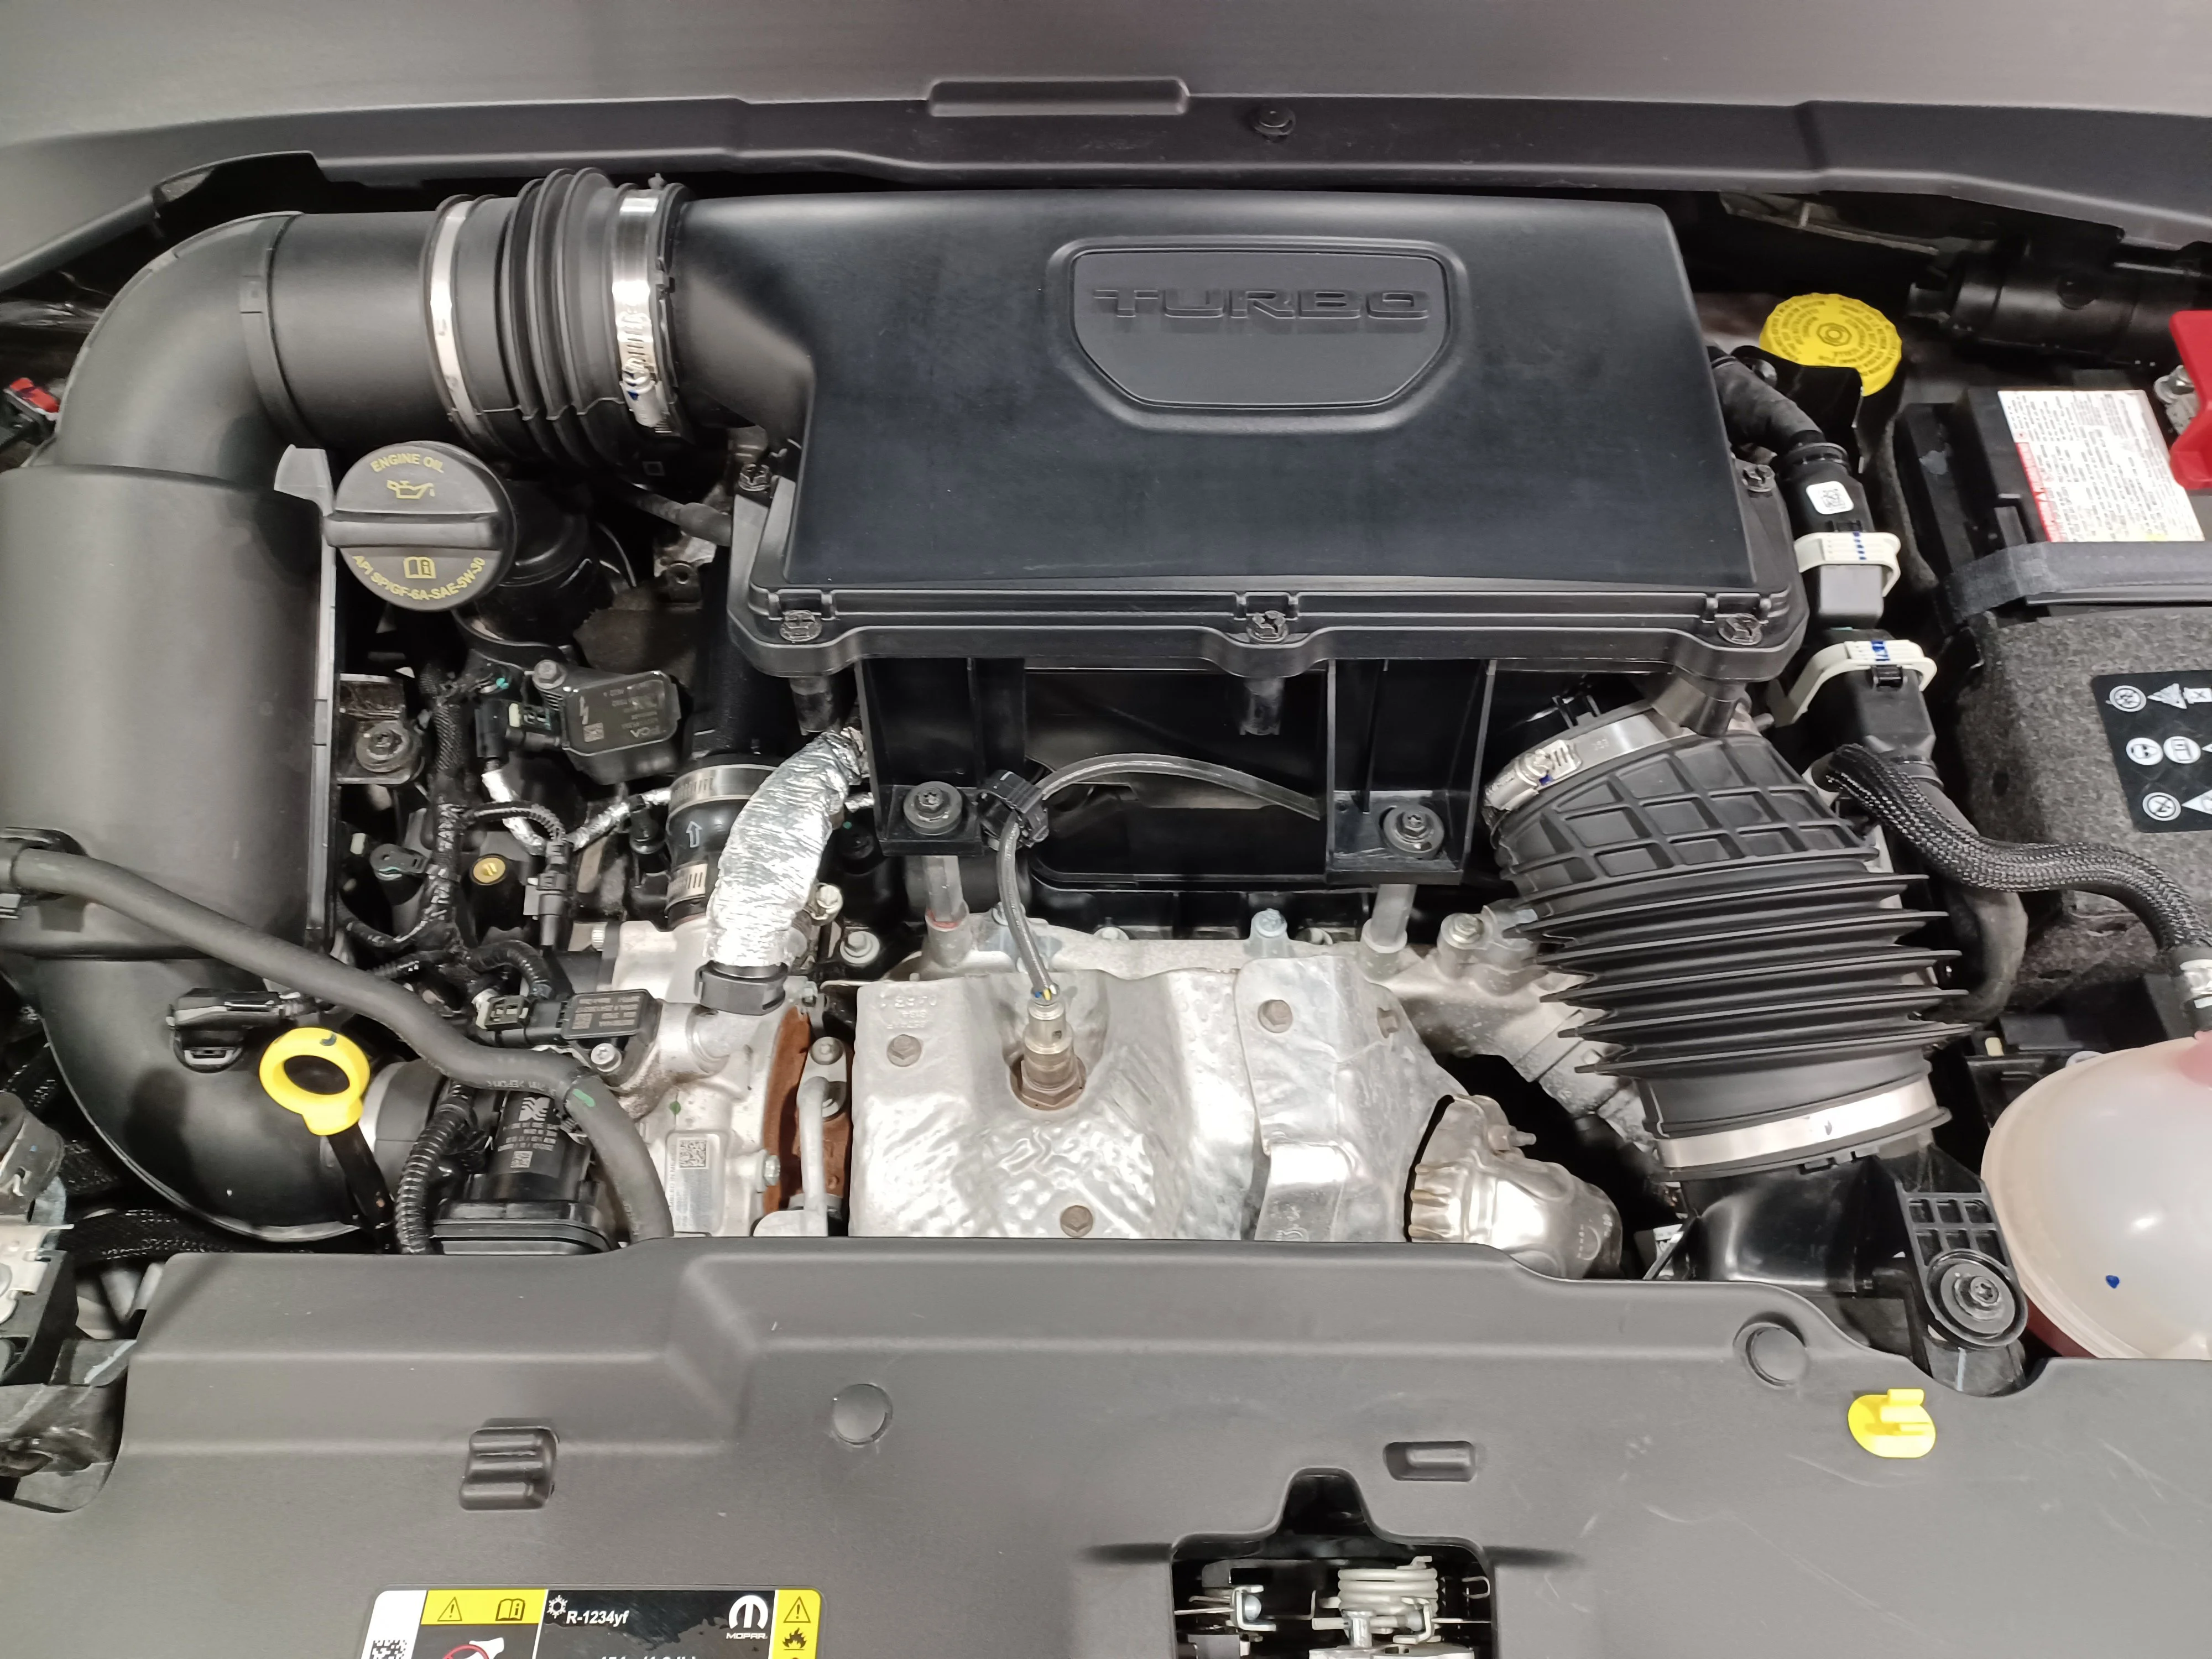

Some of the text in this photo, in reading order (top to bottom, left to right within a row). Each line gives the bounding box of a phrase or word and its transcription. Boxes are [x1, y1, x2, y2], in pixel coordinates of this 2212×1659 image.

[1093, 289, 1430, 320] TURBO
[370, 453, 445, 474] ENGINE OIL
[566, 1610, 629, 1627] R-1234yf
